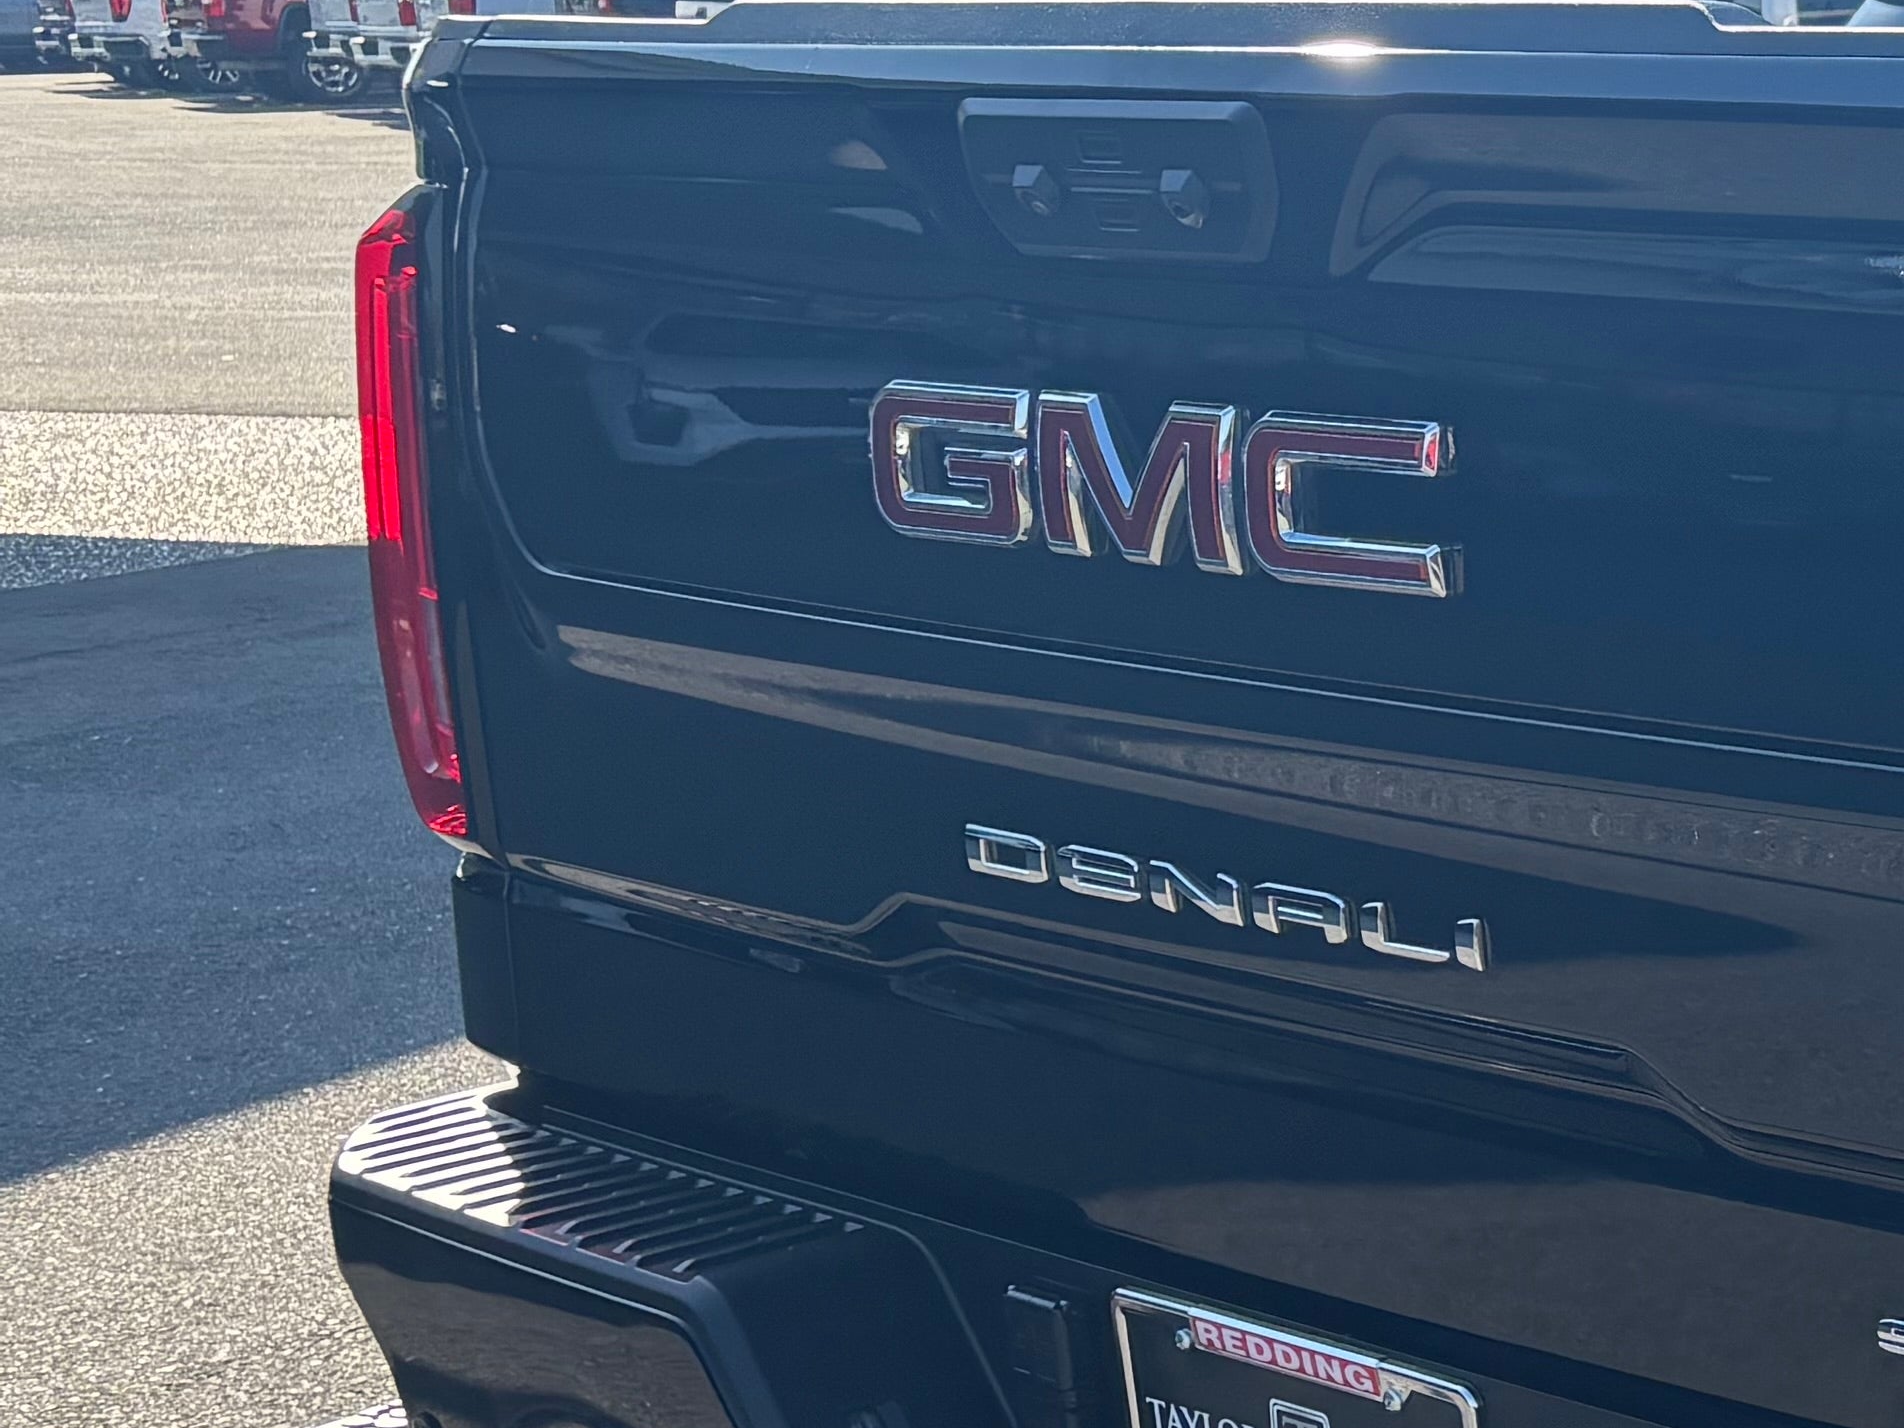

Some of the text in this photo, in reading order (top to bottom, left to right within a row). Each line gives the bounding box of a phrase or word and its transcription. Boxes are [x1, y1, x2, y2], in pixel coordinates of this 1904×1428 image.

[869, 378, 1450, 598] GMC
[964, 822, 1490, 972] DENALI
[1194, 1319, 1375, 1394] REDDING
